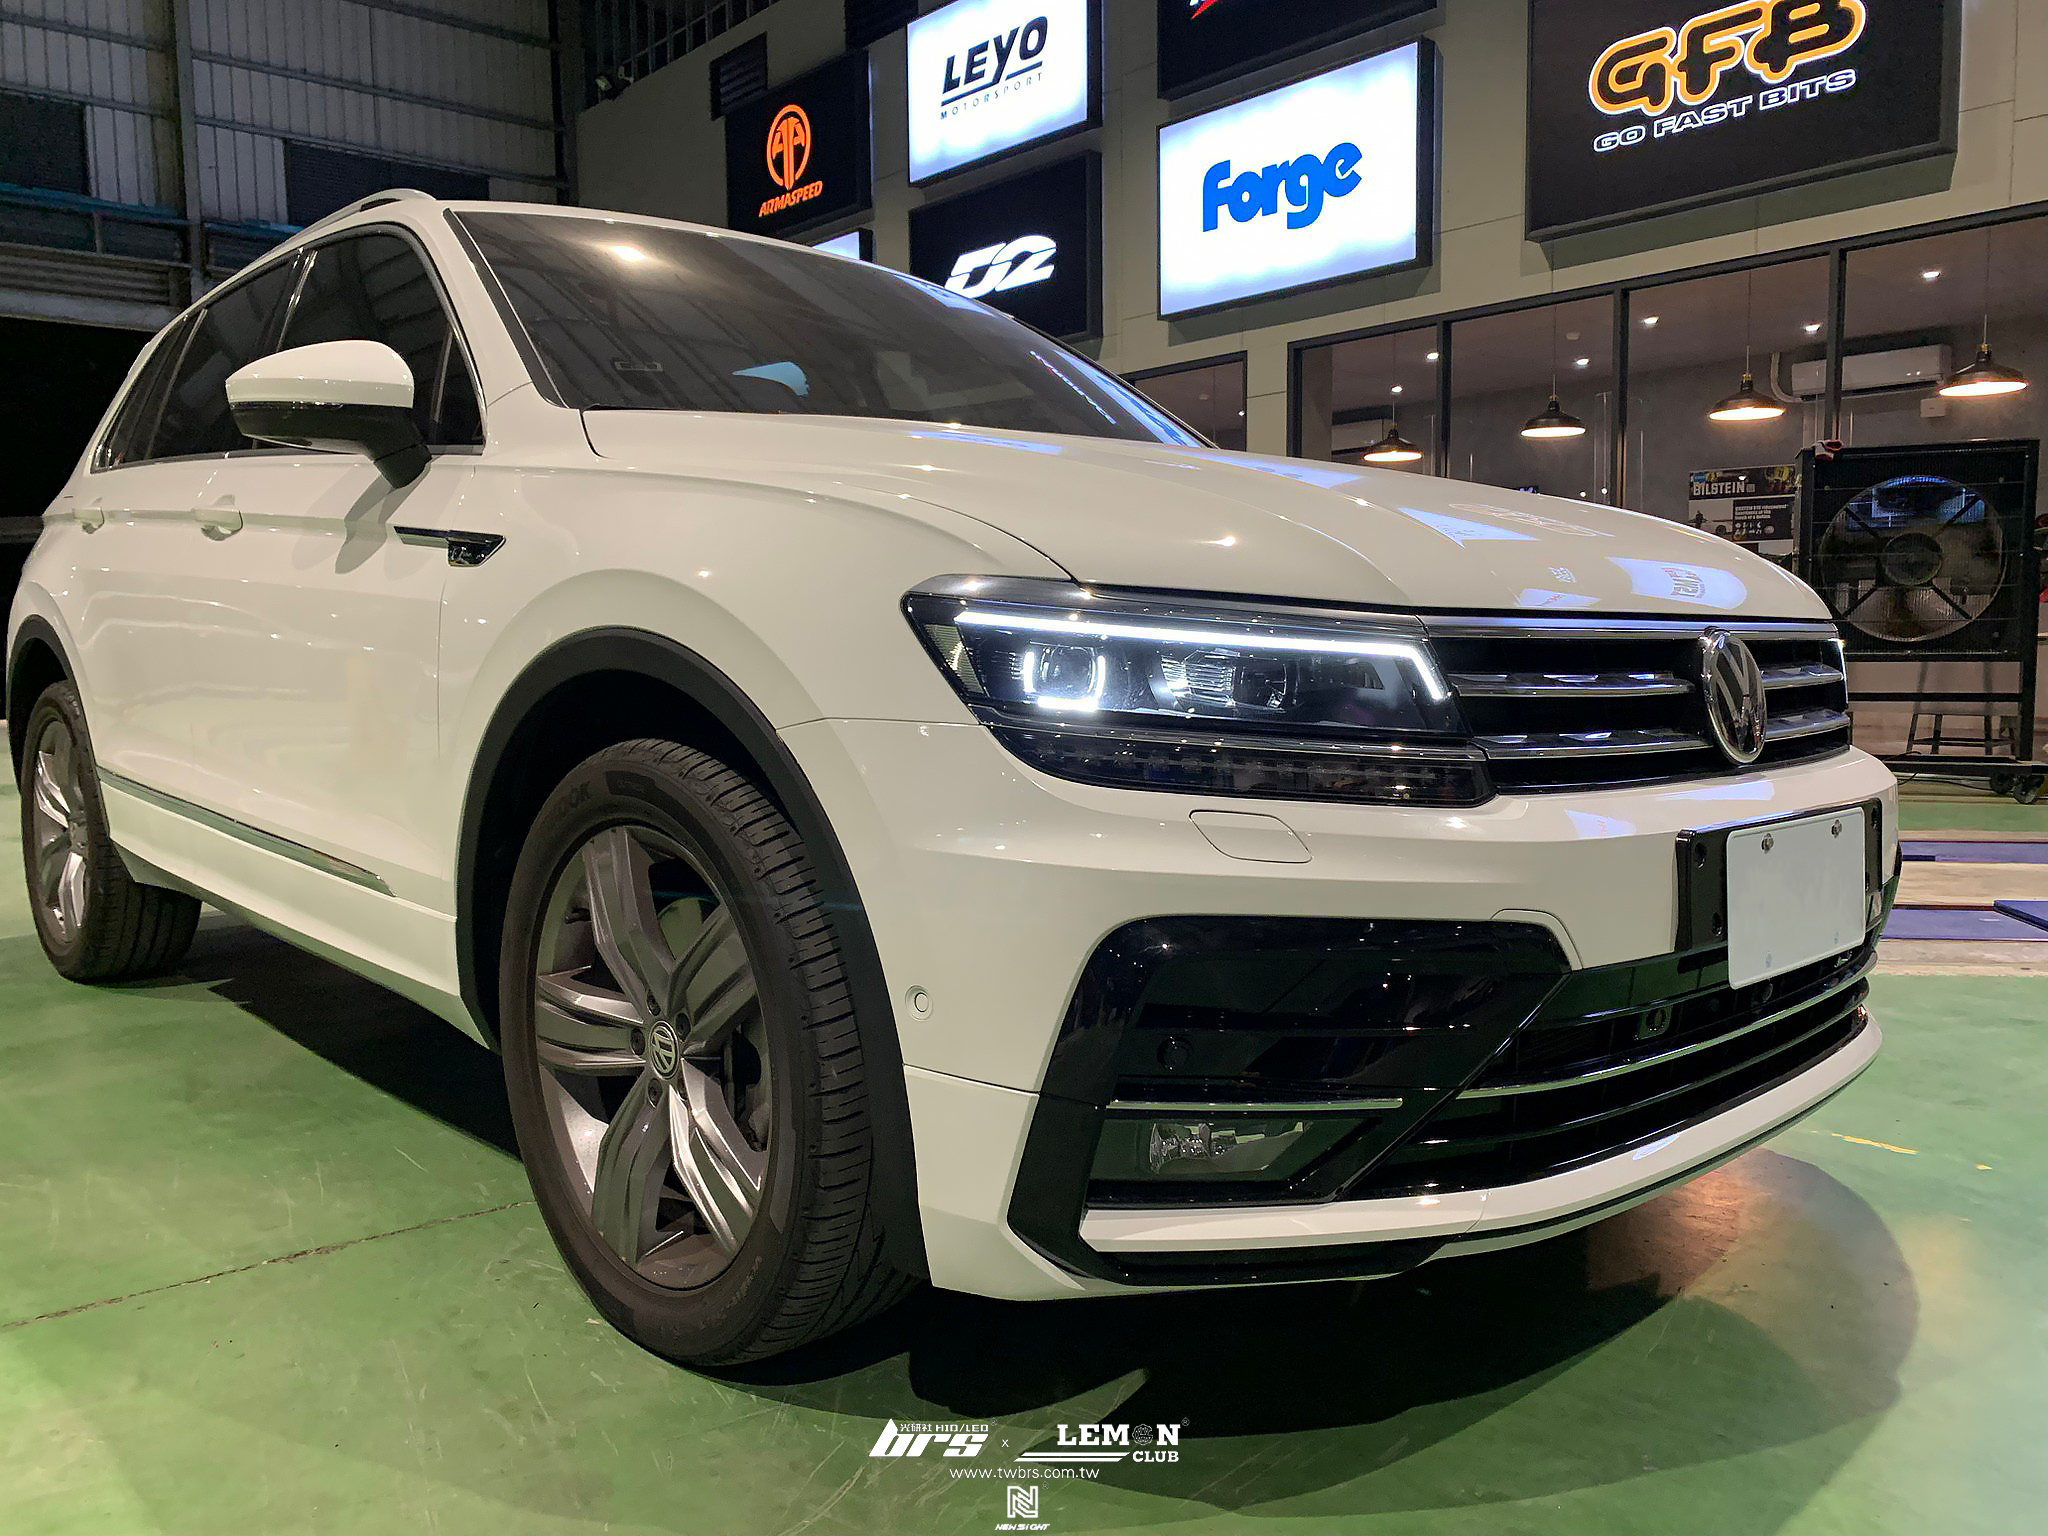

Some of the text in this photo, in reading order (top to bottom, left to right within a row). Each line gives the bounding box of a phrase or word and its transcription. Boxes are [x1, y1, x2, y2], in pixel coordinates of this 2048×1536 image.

[942, 15, 1048, 94] LEYO
[940, 72, 1042, 120] MOTORSPORT
[1594, 69, 1857, 152] GO FAST BITS
[758, 180, 824, 218] ARMASPEED
[1693, 481, 1746, 496] BILSTEIN
